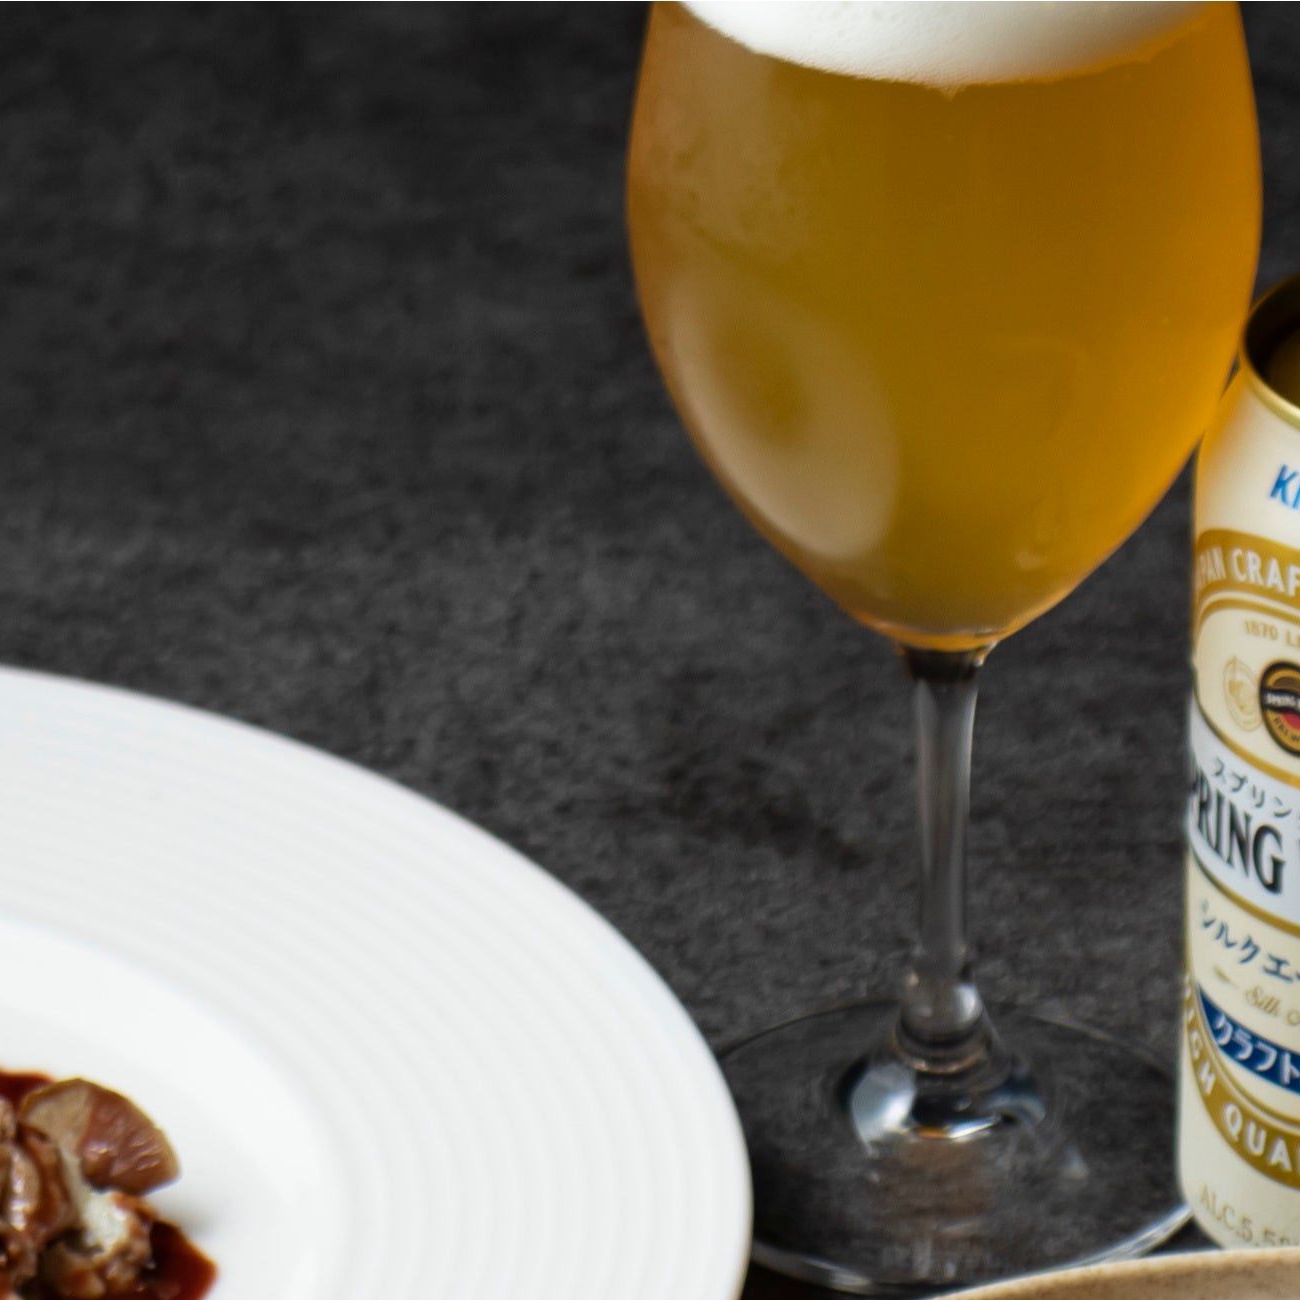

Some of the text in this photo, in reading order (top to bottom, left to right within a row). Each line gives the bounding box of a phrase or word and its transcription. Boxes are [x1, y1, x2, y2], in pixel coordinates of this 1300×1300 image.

[1244, 619, 1278, 641] 1870
[1193, 766, 1287, 895] RING
[1244, 984, 1281, 1018] Silk
